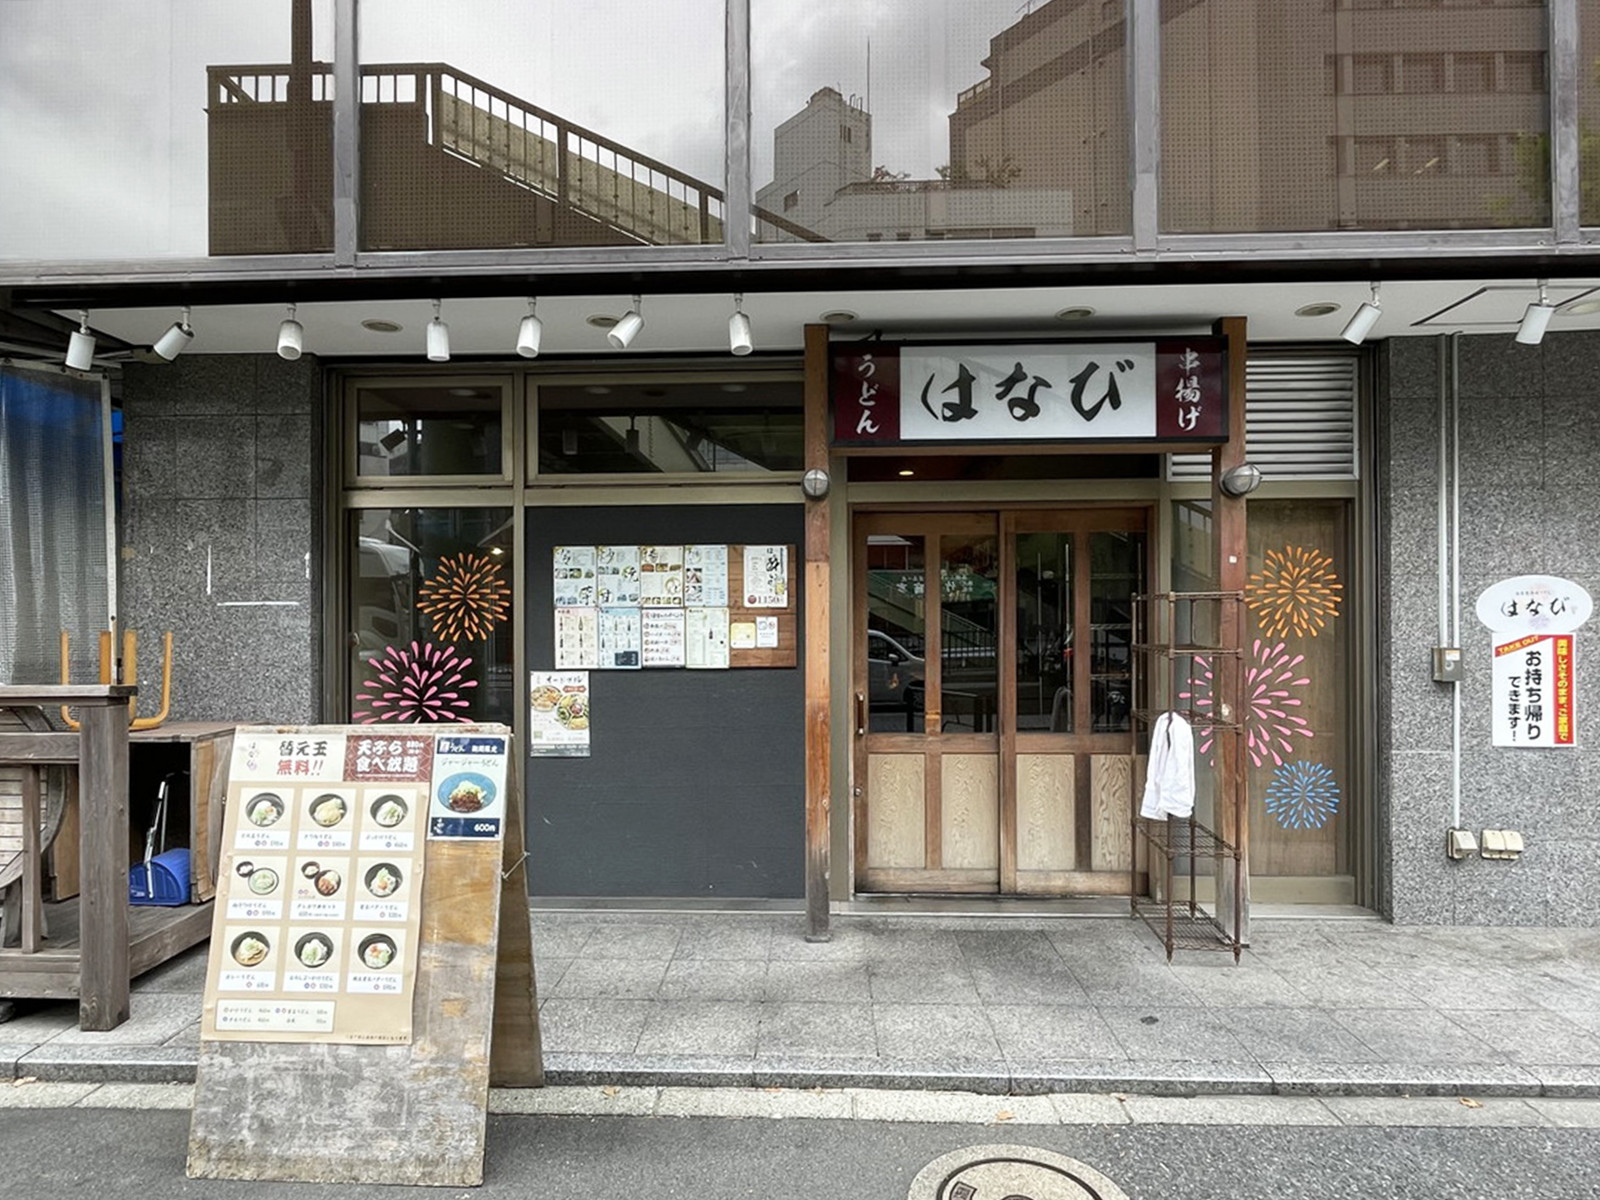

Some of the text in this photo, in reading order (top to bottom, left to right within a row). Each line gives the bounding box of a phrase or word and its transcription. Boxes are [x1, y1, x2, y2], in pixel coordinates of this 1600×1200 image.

[855, 353, 881, 435] うどん
[920, 360, 1135, 422] はなび
[1173, 347, 1203, 432] 串揚げ
[1500, 597, 1570, 617] はなび
[1497, 634, 1539, 654] TAKE OUT
[1524, 650, 1543, 740] お持ち帰り
[1508, 676, 1521, 742] できます!
[357, 739, 402, 755] 天ぷら
[277, 759, 324, 776] 無料!!
[356, 755, 418, 773] 食べ放題
[474, 823, 496, 832] 600円
